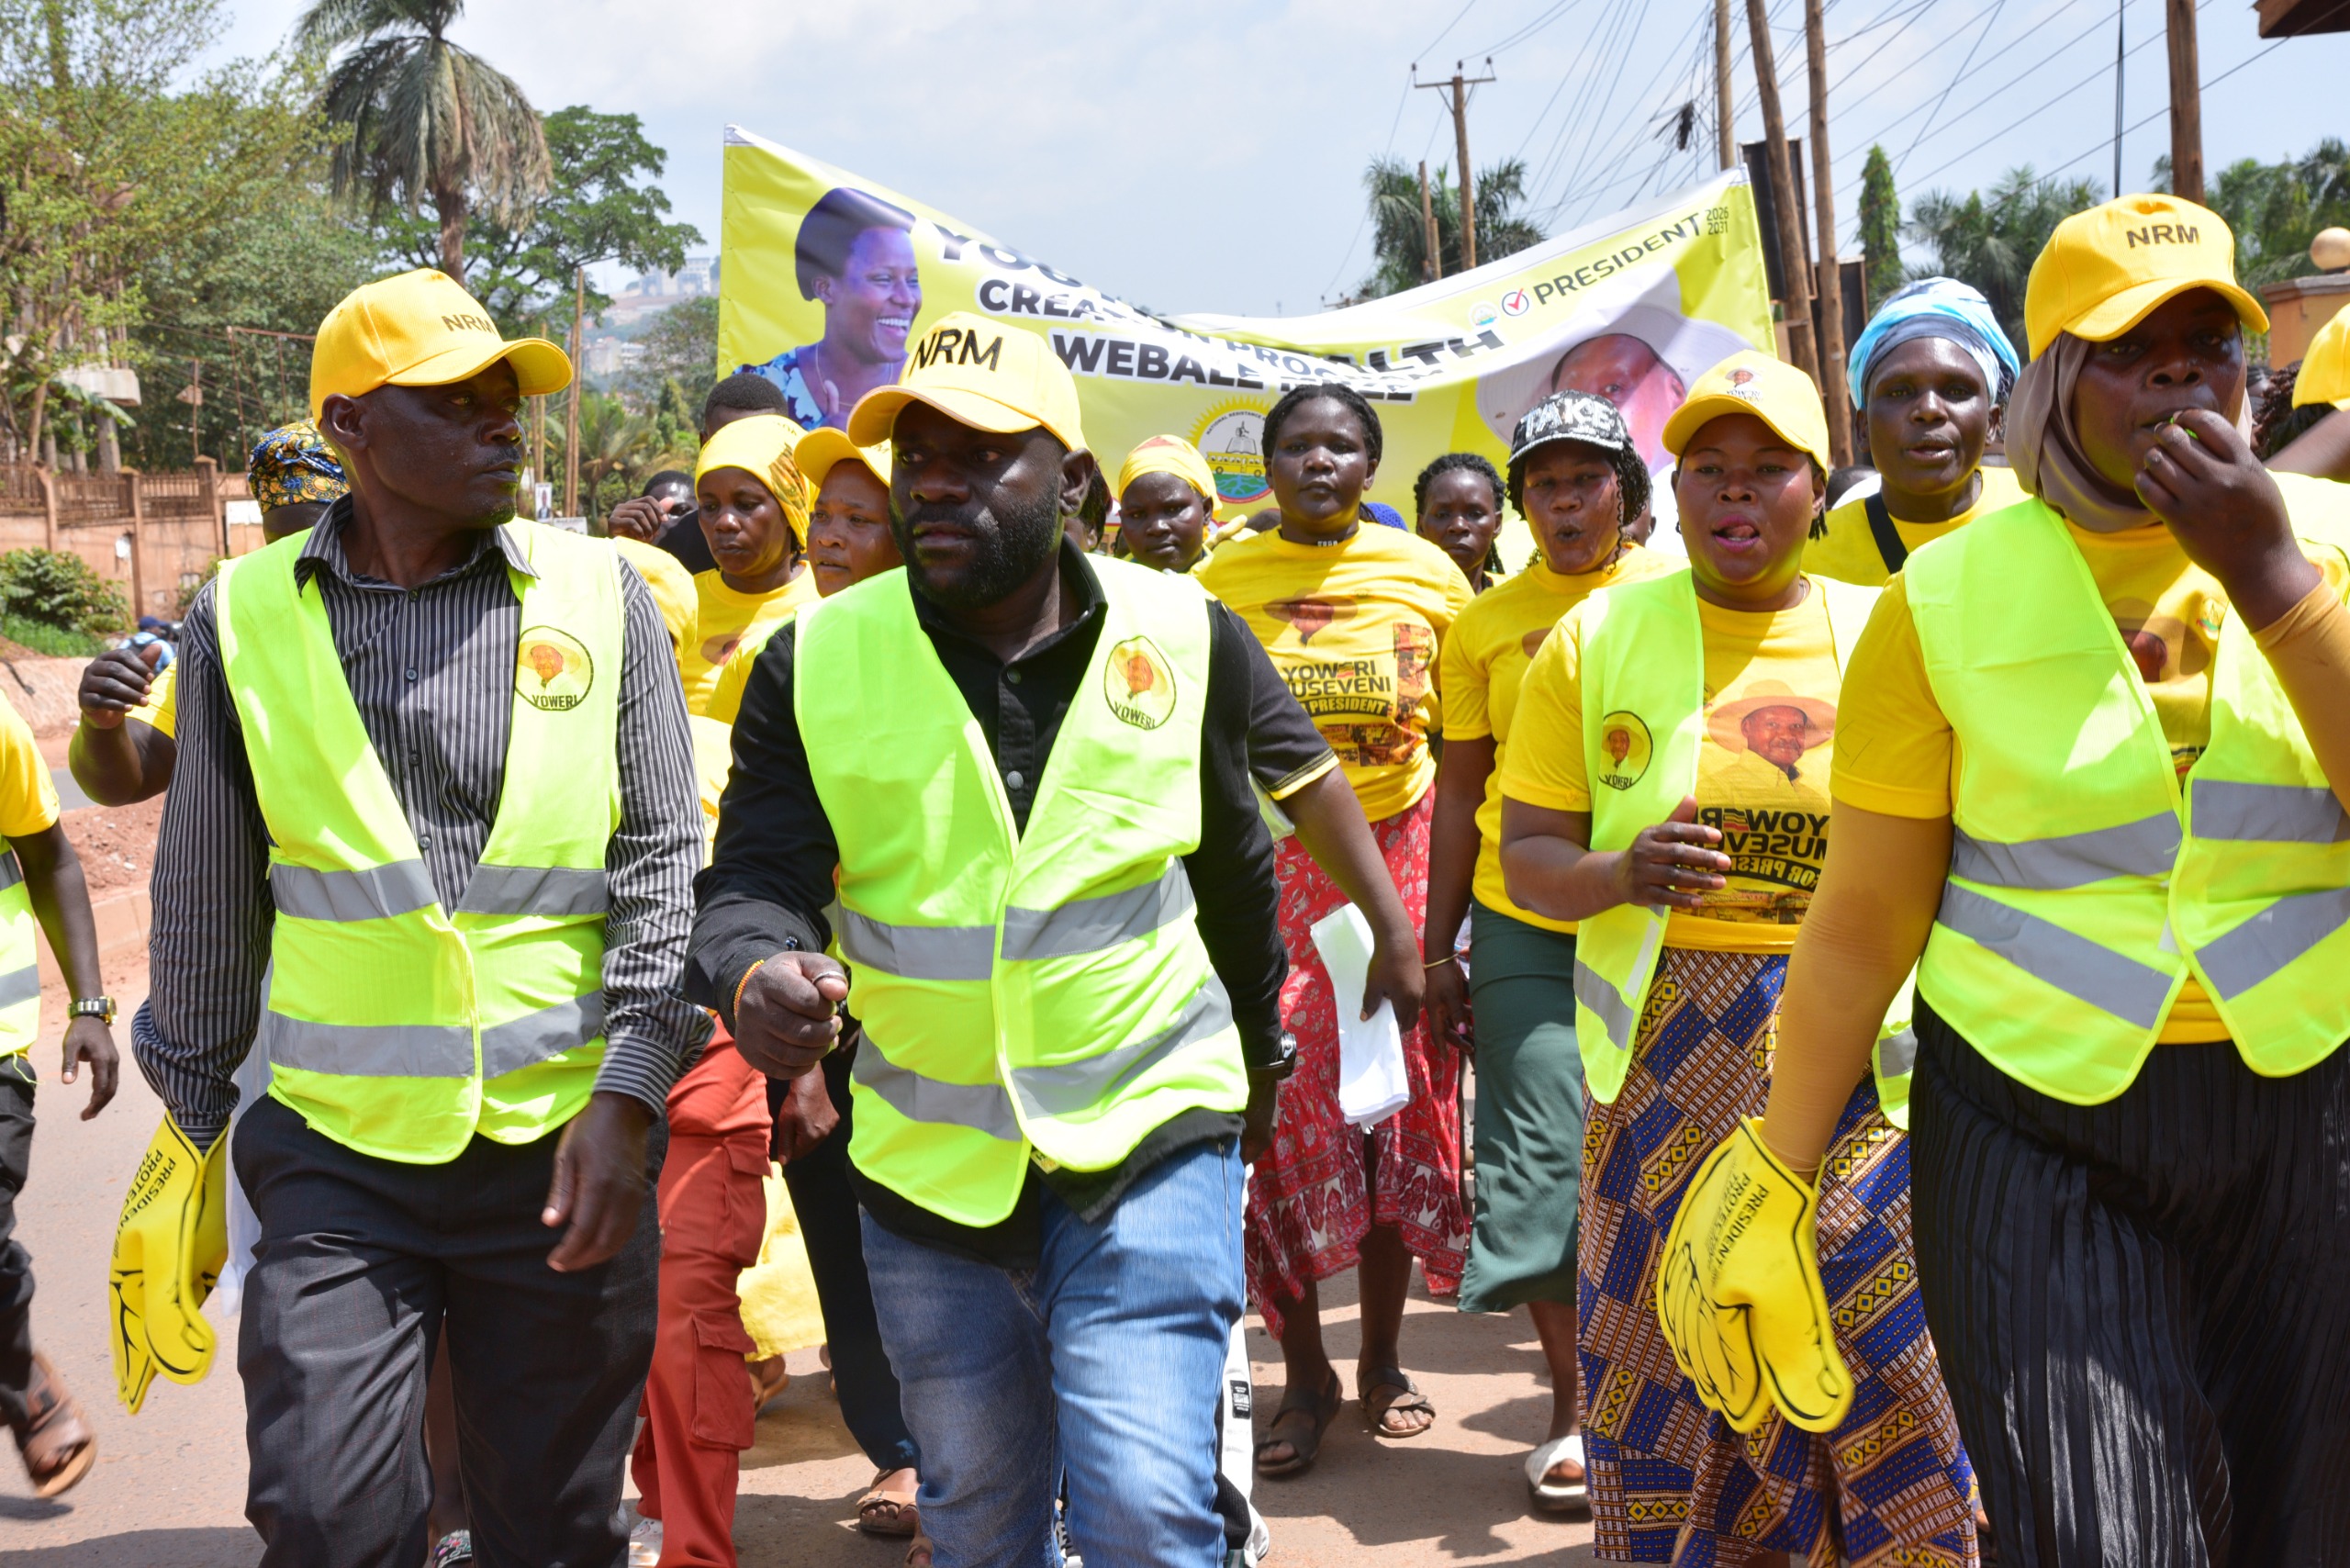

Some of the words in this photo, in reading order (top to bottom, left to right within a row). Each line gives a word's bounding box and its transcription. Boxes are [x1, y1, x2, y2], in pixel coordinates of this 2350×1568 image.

[1706, 207, 1729, 221] 2026
[1707, 221, 1729, 235] 2031
[2126, 224, 2199, 248] NRM
[1533, 213, 1699, 305] PRESIDENT
[442, 314, 497, 335] NRM
[908, 329, 1002, 378] NRM
[1291, 677, 1391, 698] USEVENI
[532, 694, 577, 708] YOWERI
[1309, 698, 1386, 713] PRESIDENT
[1114, 700, 1156, 730] YOWERI
[118, 1157, 176, 1238] PRESIDENT
[1716, 1183, 1770, 1267] PRESIDENT
